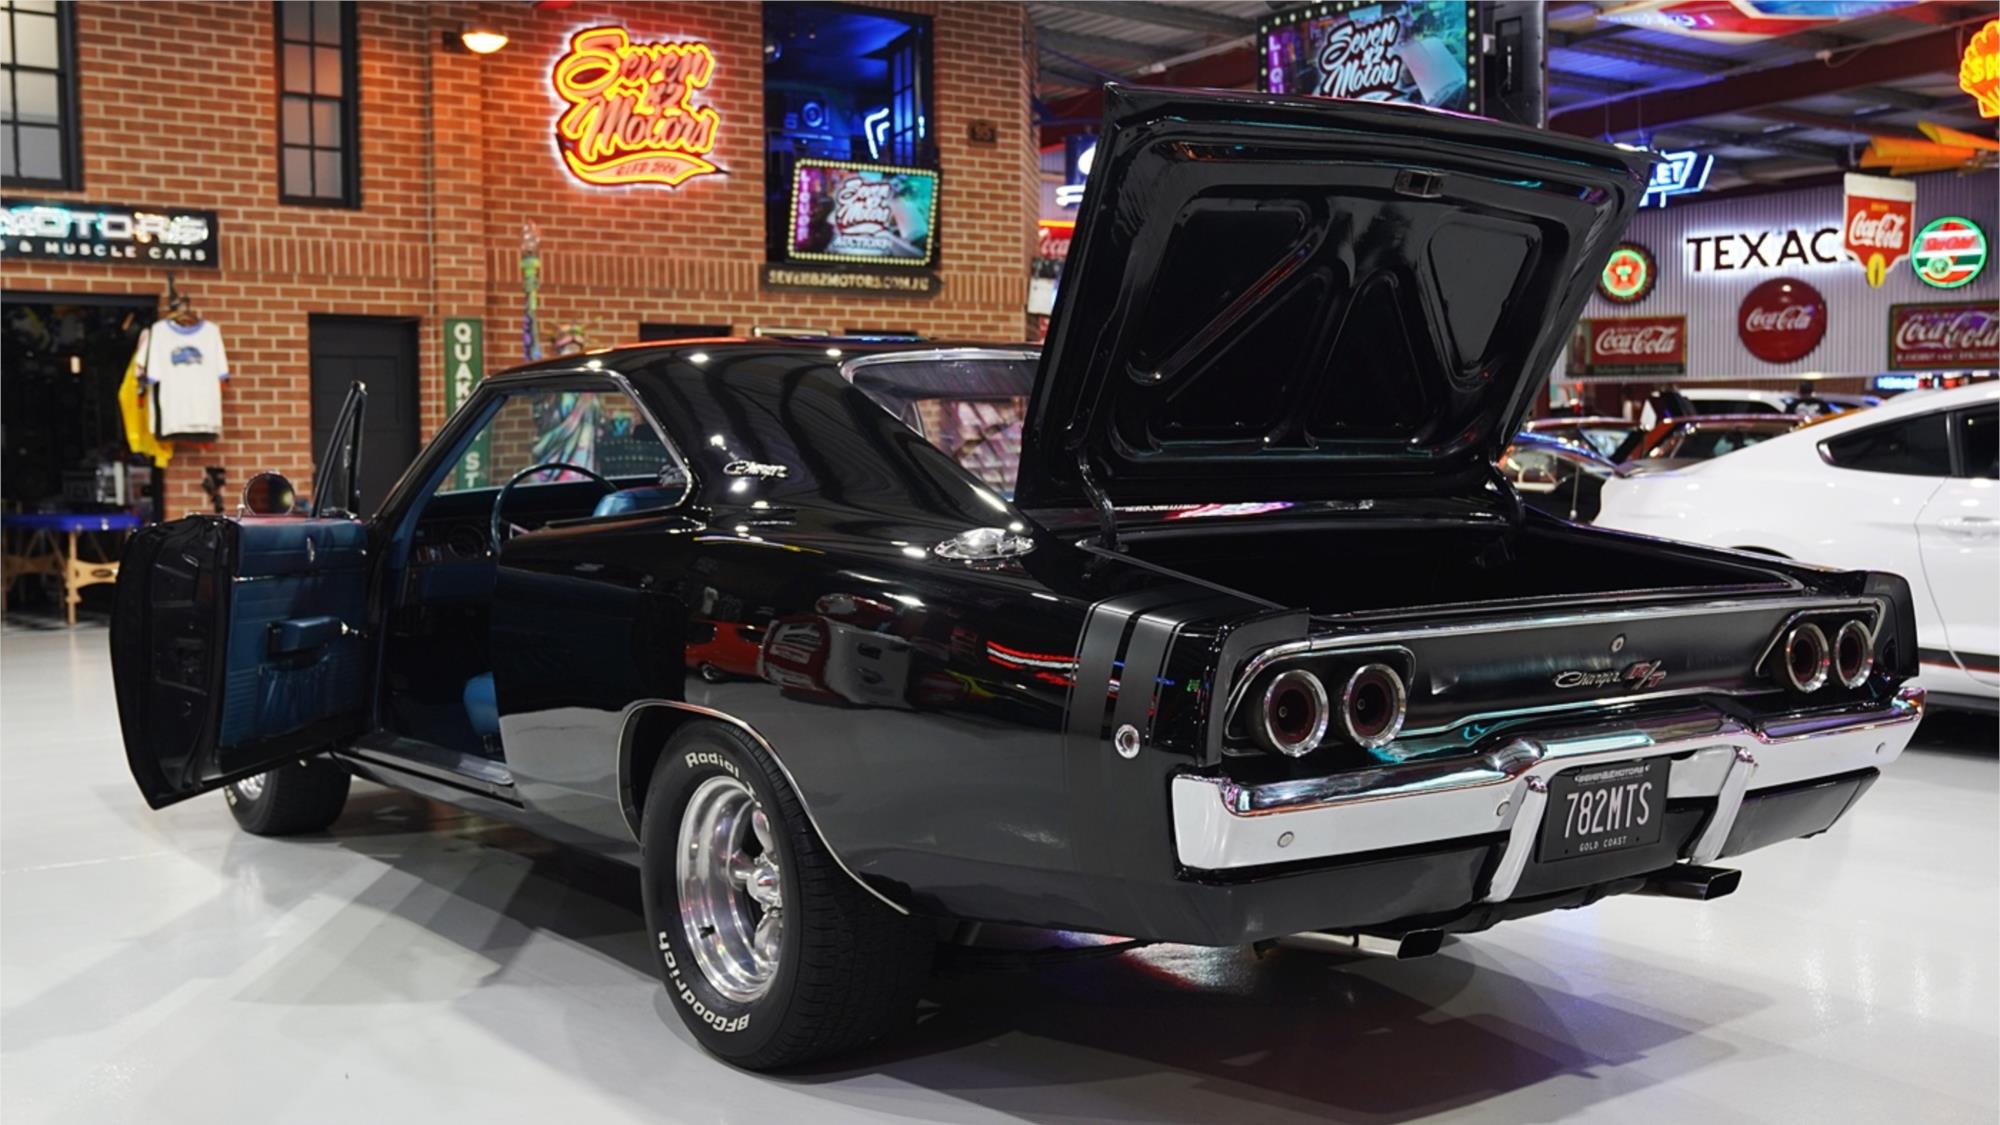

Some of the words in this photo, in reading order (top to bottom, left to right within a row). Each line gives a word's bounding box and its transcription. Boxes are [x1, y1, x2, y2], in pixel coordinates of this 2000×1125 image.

[558, 28, 713, 101] Seven
[1322, 20, 1396, 71] Seven
[1323, 58, 1399, 98] Motors
[566, 95, 714, 161] Motors
[45, 241, 137, 258] MUSCLE
[149, 247, 206, 261] CARS
[1686, 227, 1857, 273] TEXAC
[685, 751, 740, 779] Radial
[1564, 781, 1653, 839] 782MTS
[1579, 840, 1600, 852] GOLD
[1603, 835, 1629, 848] COAST
[658, 931, 752, 1033] BFGoodrich
